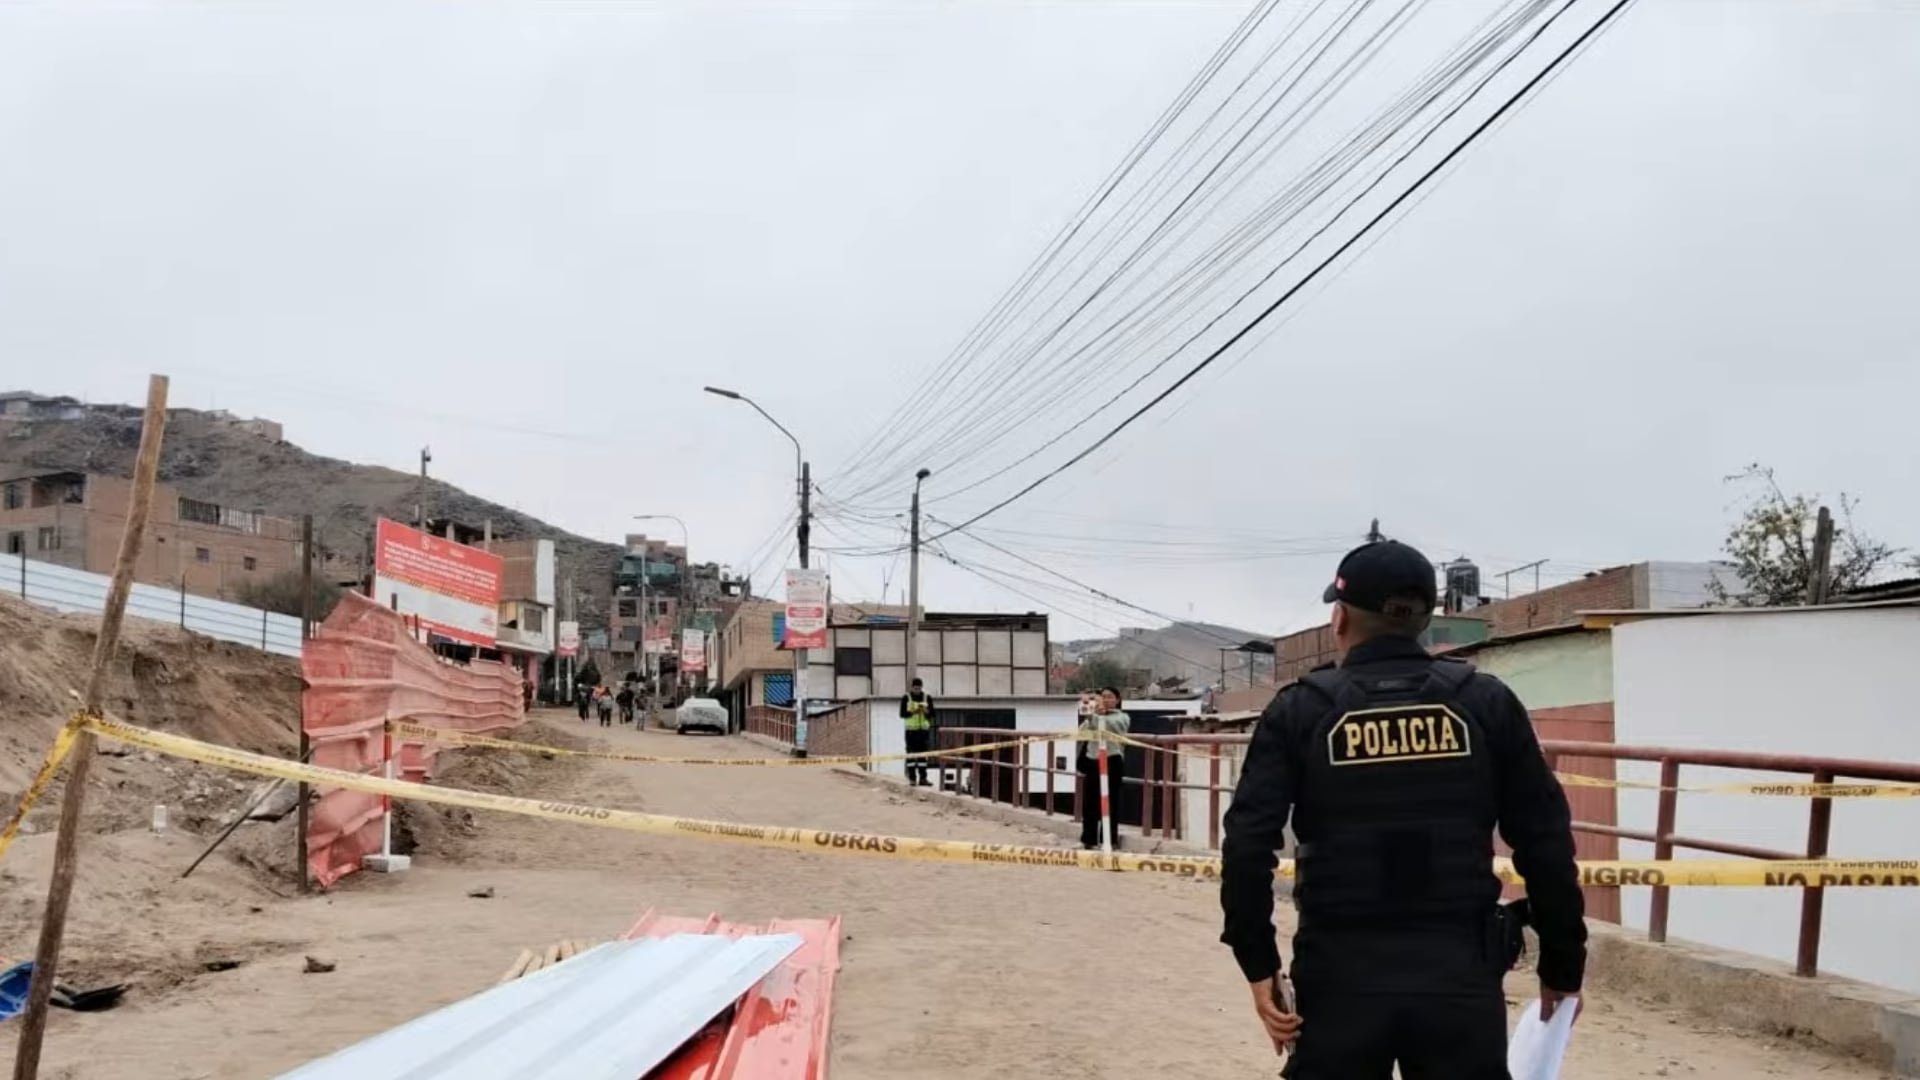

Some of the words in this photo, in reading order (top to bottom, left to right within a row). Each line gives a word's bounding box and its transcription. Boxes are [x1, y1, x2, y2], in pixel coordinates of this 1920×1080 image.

[1344, 716, 1459, 758] POLICIA
[814, 831, 898, 854] OBRAS
[1582, 866, 1666, 886] IGRO
